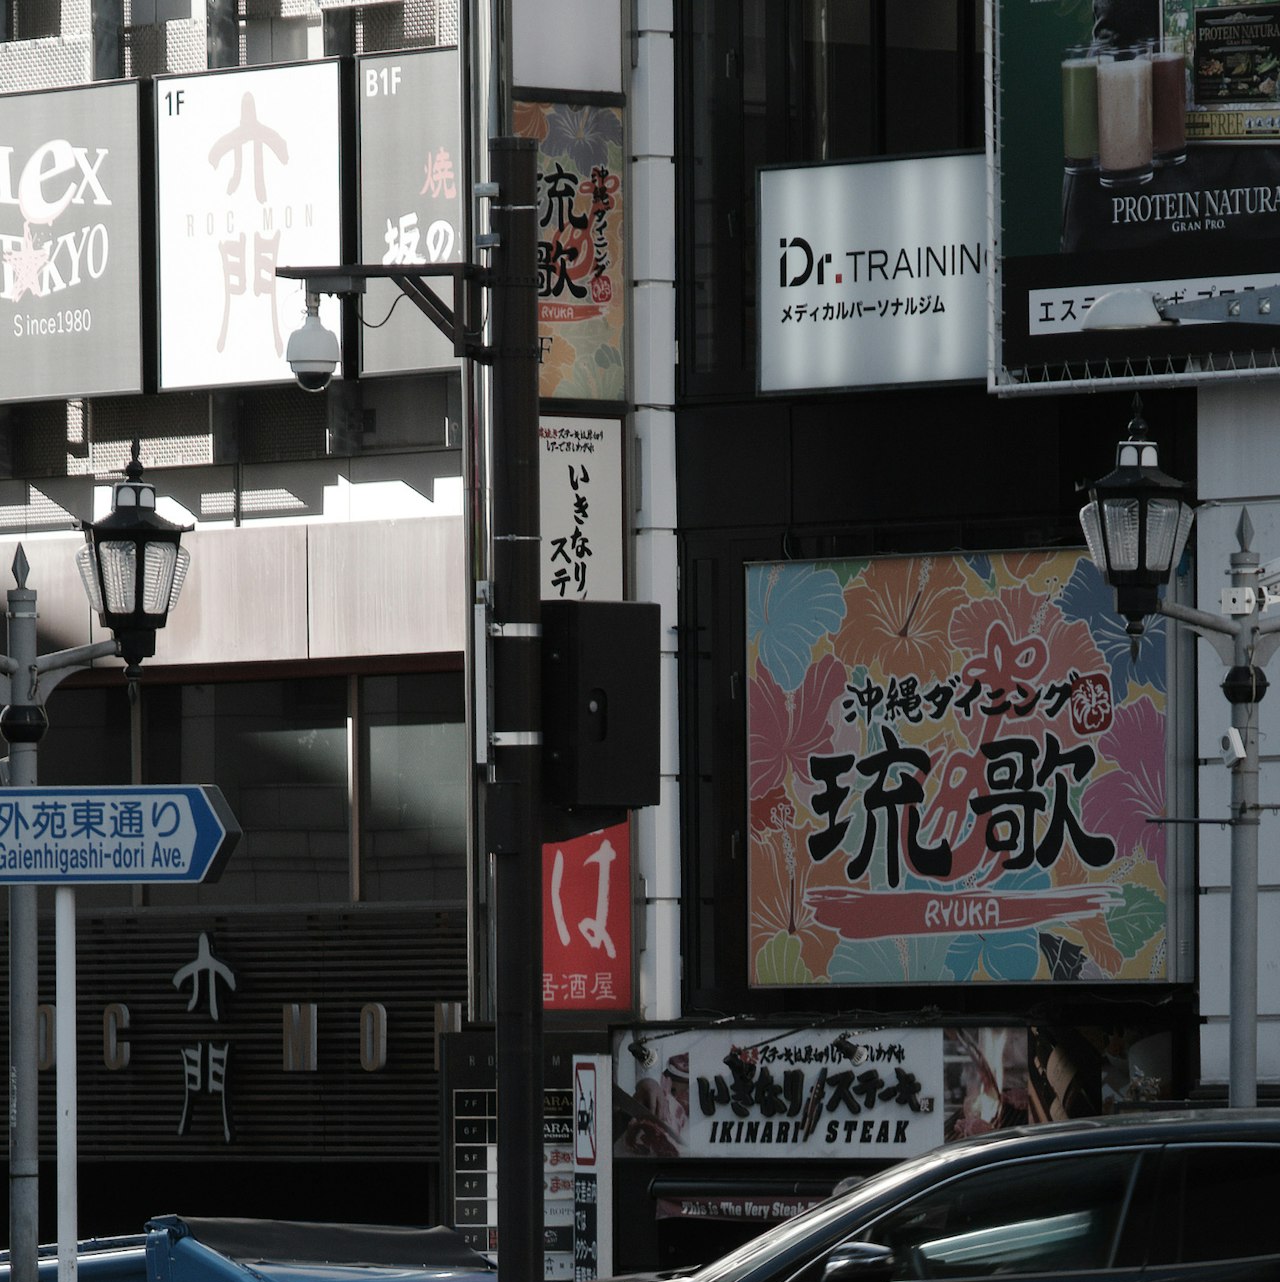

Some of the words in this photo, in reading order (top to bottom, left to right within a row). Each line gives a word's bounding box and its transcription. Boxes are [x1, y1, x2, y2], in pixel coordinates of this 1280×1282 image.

[1199, 26, 1240, 41] PROTEIN
[1240, 23, 1280, 39] NATURA
[365, 66, 402, 98] B1F
[164, 90, 185, 116] 1F
[185, 210, 235, 238] ROC
[262, 203, 314, 232] MON
[1111, 192, 1201, 225] PROTEIN
[381, 212, 462, 266] 坂の
[541, 305, 575, 319] RYUKA
[781, 295, 946, 324] メディカルパーソナルジム
[538, 336, 554, 364] F
[567, 464, 593, 593] いきなり
[843, 673, 1078, 724] 沖縄ダイニング
[807, 724, 1117, 890] 琉歌
[150, 848, 186, 869] Ave.
[924, 898, 1001, 928] RYUKA
[542, 972, 618, 1002] 居酒屋
[709, 1121, 802, 1144] IKINARI
[824, 1120, 910, 1144] STEAK
[464, 1153, 478, 1162] 5F
[464, 1180, 478, 1190] 4F
[464, 1207, 478, 1217] 3F
[680, 1201, 708, 1216] This
[708, 1201, 719, 1216] is
[720, 1202, 743, 1217] The
[744, 1202, 770, 1220] Very
[770, 1201, 805, 1217] Steak
[464, 1234, 478, 1244] 2F
